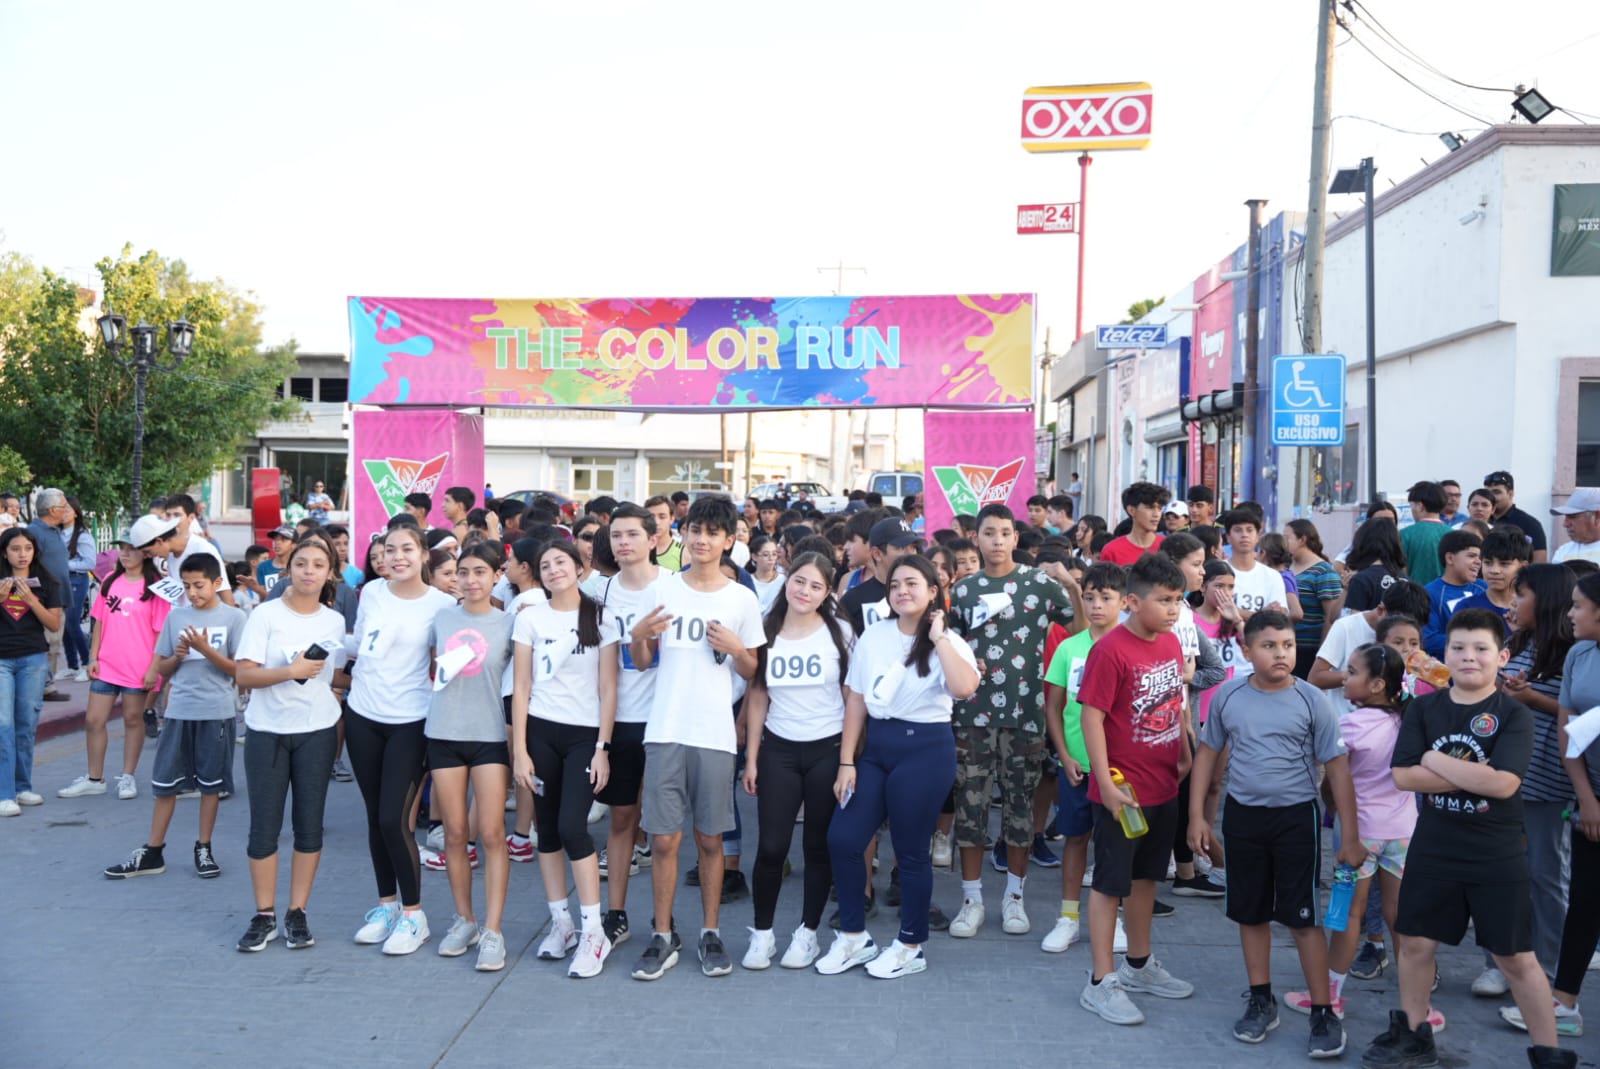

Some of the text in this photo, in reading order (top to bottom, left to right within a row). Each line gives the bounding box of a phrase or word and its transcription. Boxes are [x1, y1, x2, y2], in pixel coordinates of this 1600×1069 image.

[1025, 97, 1147, 137] OXXO
[1045, 206, 1072, 223] 24
[1101, 327, 1161, 342] telcel
[486, 326, 900, 370] THE COLOR RUN
[1294, 414, 1320, 426] USO
[1277, 427, 1338, 440] EXCLUSIVO
[156, 580, 184, 598] 140
[671, 616, 722, 642] 10
[770, 653, 822, 679] 096
[1138, 664, 1178, 692] STREET
